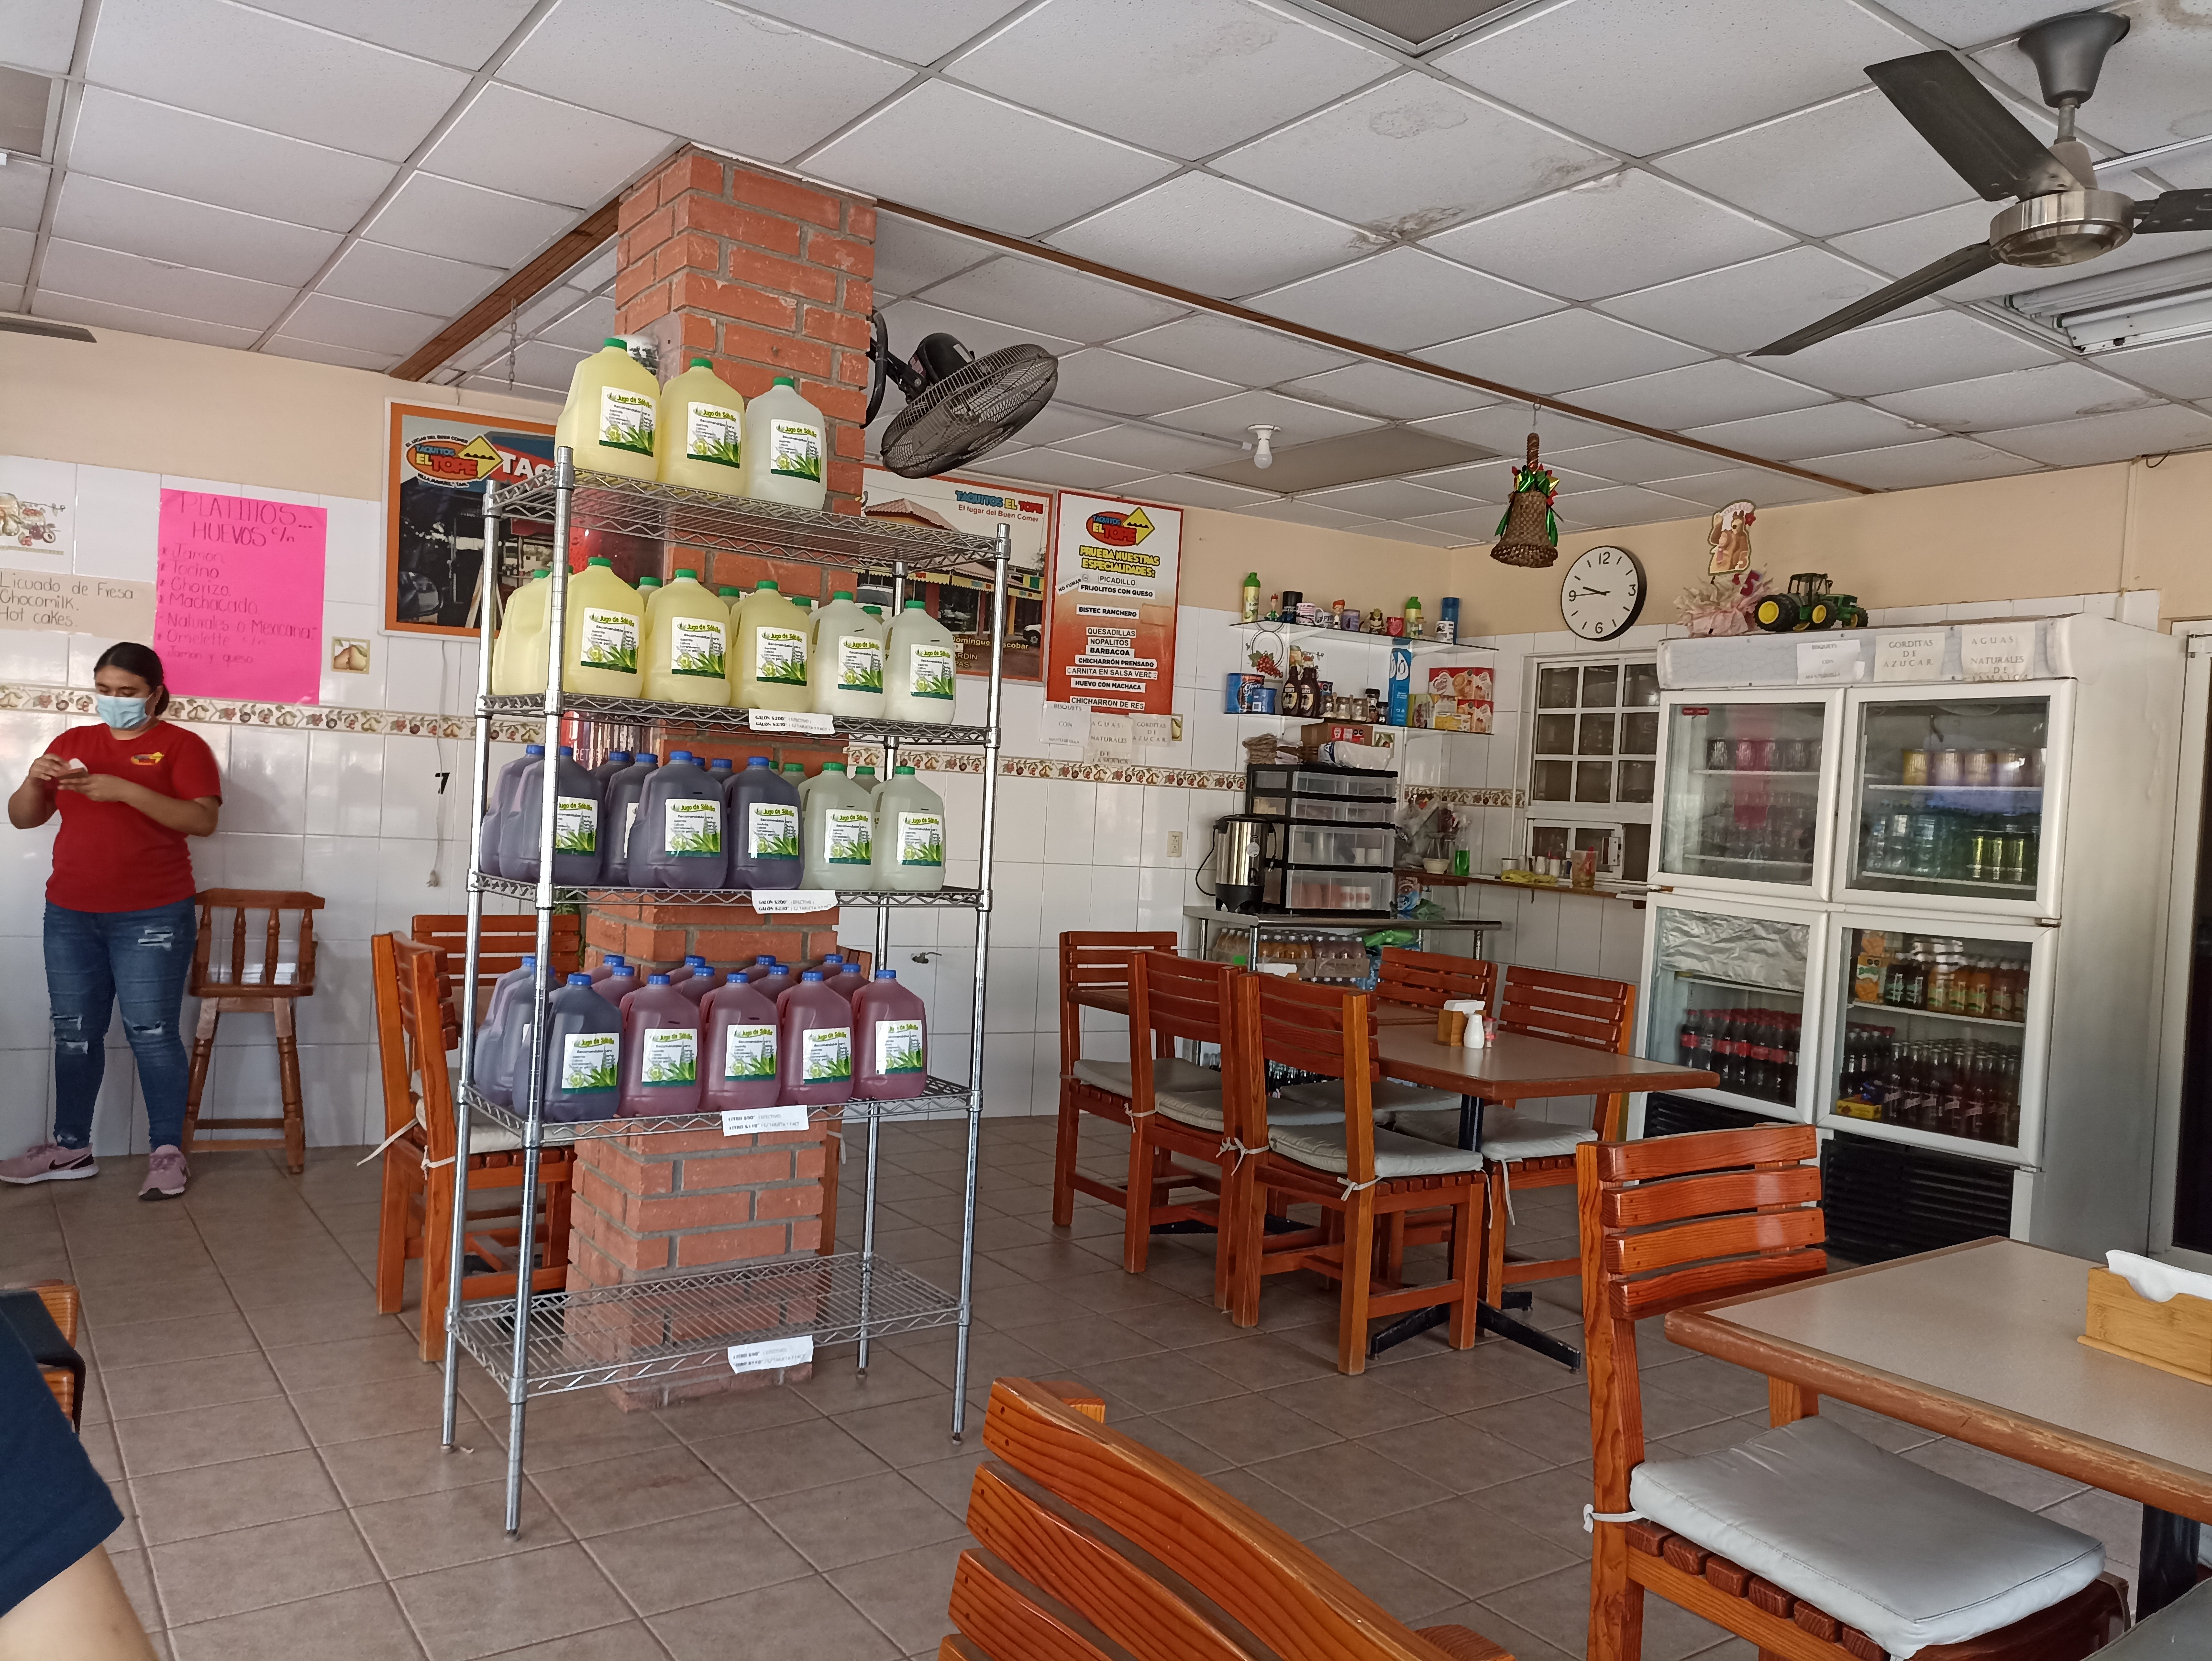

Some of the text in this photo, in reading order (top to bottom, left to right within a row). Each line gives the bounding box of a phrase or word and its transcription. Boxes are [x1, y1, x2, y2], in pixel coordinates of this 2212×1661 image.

[415, 444, 455, 456] TAQUITOS
[416, 454, 478, 475] EL TOPE
[955, 490, 1043, 514] TAQUITOS EL TOPE
[967, 506, 984, 514] lugar
[1018, 514, 1039, 522] Comer
[1093, 515, 1120, 525] TAQUITOS
[192, 521, 266, 547] HUEVOS
[1093, 523, 1137, 542] EL TOPE
[1079, 545, 1160, 566] PRUEBA NUESTRAS
[1598, 552, 1611, 565] 12
[171, 559, 219, 579] Tocino
[0, 572, 133, 599] Licuado de Fresa
[1066, 578, 1082, 588] FUMAR
[1100, 576, 1135, 586] PICADILLO
[1081, 585, 1117, 593] FRIJOLITOS
[1628, 584, 1637, 597] 3
[1569, 590, 1577, 601] 9
[1088, 628, 1135, 637] QUESADILLAS
[1595, 622, 1603, 634] 6
[952, 636, 992, 645] Domíngue
[1889, 640, 1933, 648] GORDITAS
[1090, 647, 1130, 655] BARBACOA
[1883, 659, 1933, 667] AZUCAR
[1971, 656, 2024, 665] NATURALES
[1072, 697, 1117, 707] CHICHARRON
[435, 772, 450, 795] 7
